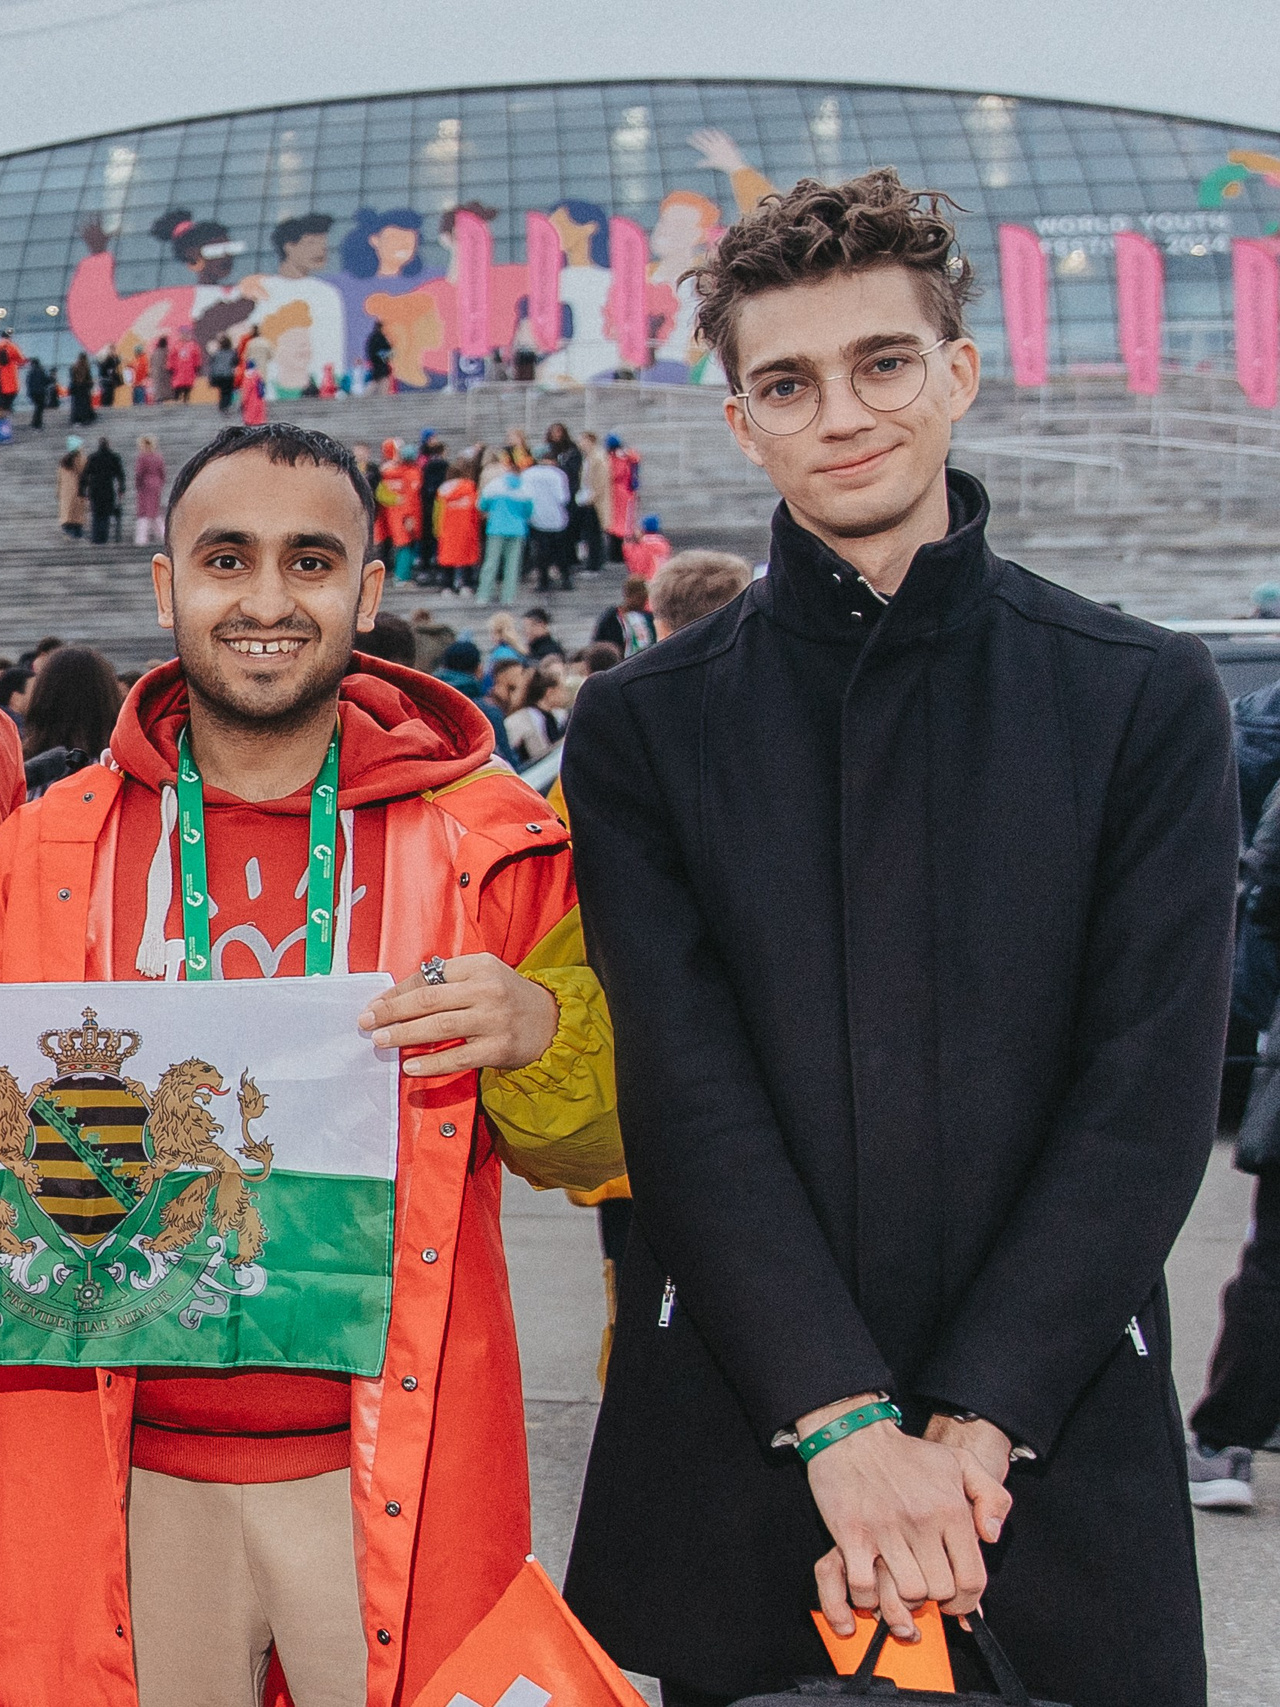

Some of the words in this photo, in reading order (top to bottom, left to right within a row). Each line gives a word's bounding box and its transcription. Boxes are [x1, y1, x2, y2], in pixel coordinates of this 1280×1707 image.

[1034, 214, 1132, 234] WORLD
[1139, 211, 1231, 233] YOUTH
[2, 1287, 109, 1334] PROVIDENTIAE
[114, 1290, 173, 1328] MEMOR
